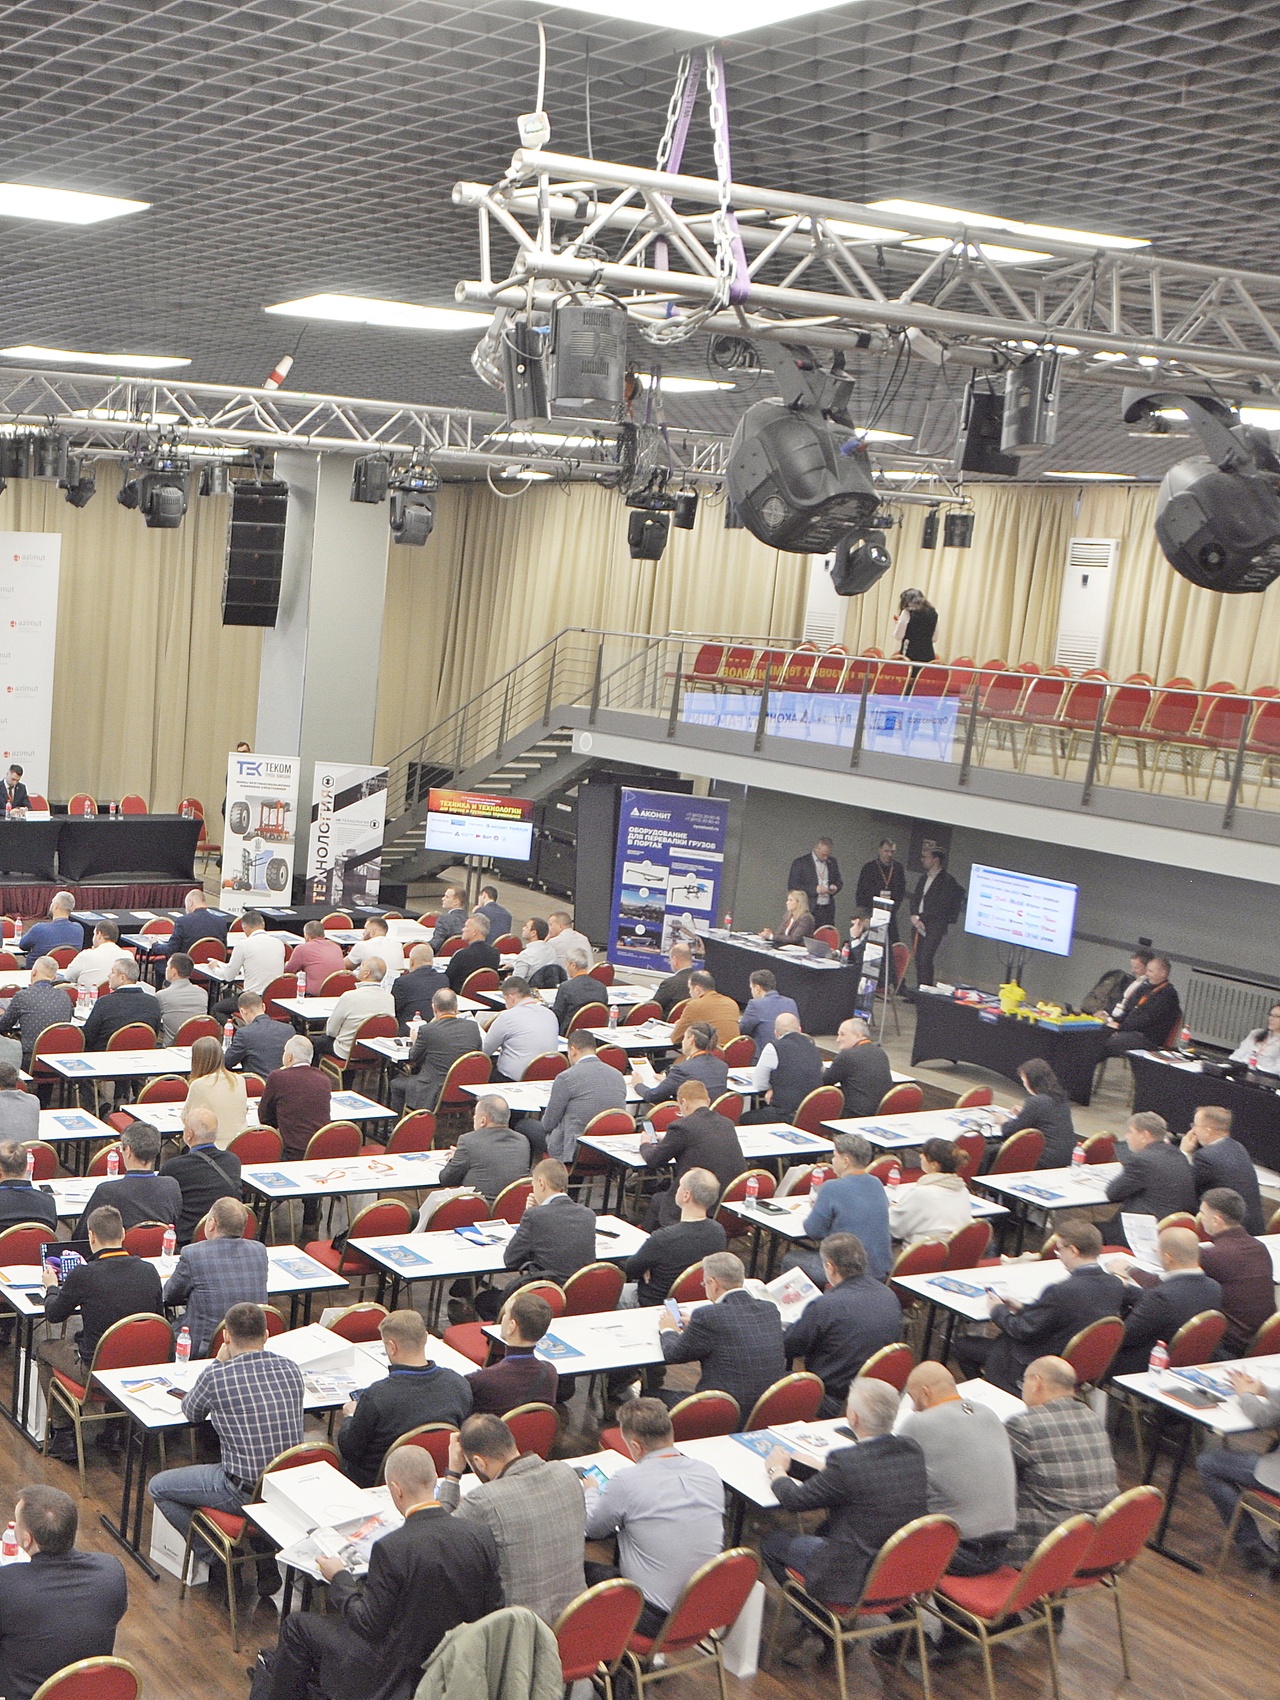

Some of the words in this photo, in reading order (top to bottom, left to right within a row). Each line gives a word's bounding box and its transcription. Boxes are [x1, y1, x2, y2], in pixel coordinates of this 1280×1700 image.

[640, 810, 672, 820] АКОНИТ
[628, 826, 688, 839] ОБОРУДОВАНИЕ
[312, 789, 333, 903] ТЕХНОЛОГИЯ
[627, 833, 644, 841] ДЛЯ
[644, 834, 688, 846] ПЕРЕВАЛКИ
[688, 840, 716, 849] ГРУЗОВ
[634, 840, 663, 849] ПОРТАХ
